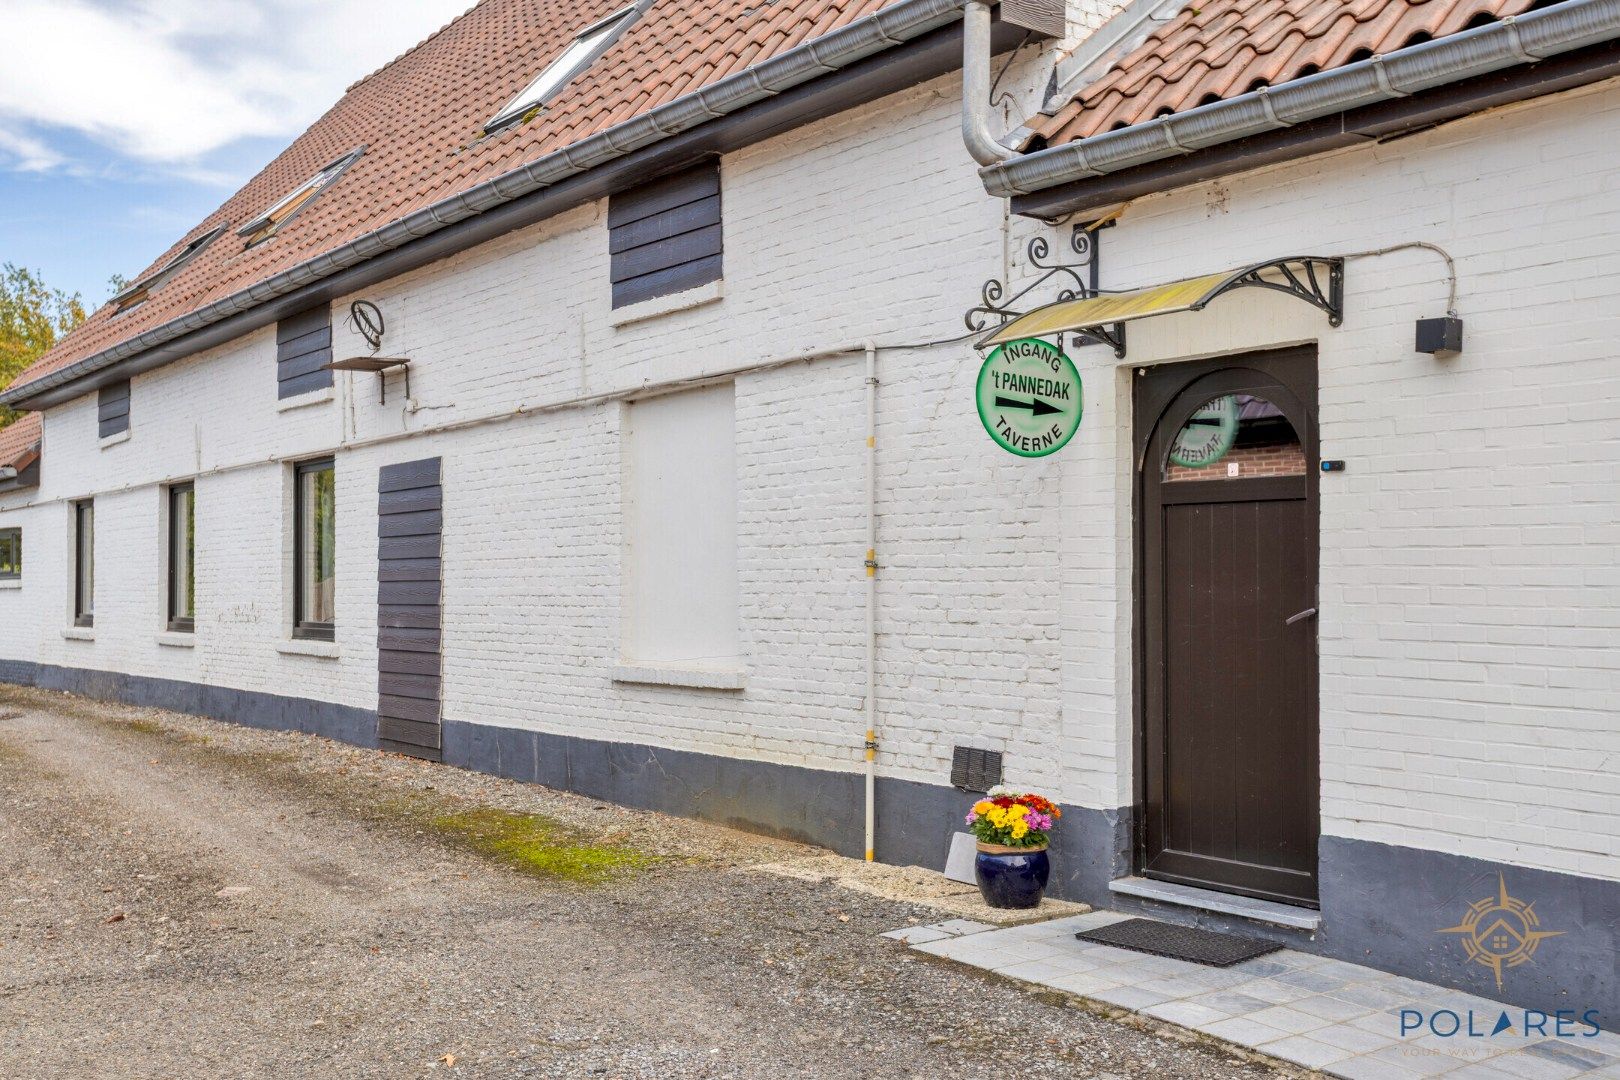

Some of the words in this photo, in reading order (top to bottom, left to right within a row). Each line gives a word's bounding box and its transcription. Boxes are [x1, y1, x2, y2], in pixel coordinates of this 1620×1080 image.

[1004, 342, 1061, 373] INGANG
[1002, 372, 1070, 400] PANNEDAK
[996, 415, 1062, 451] TAVERNE
